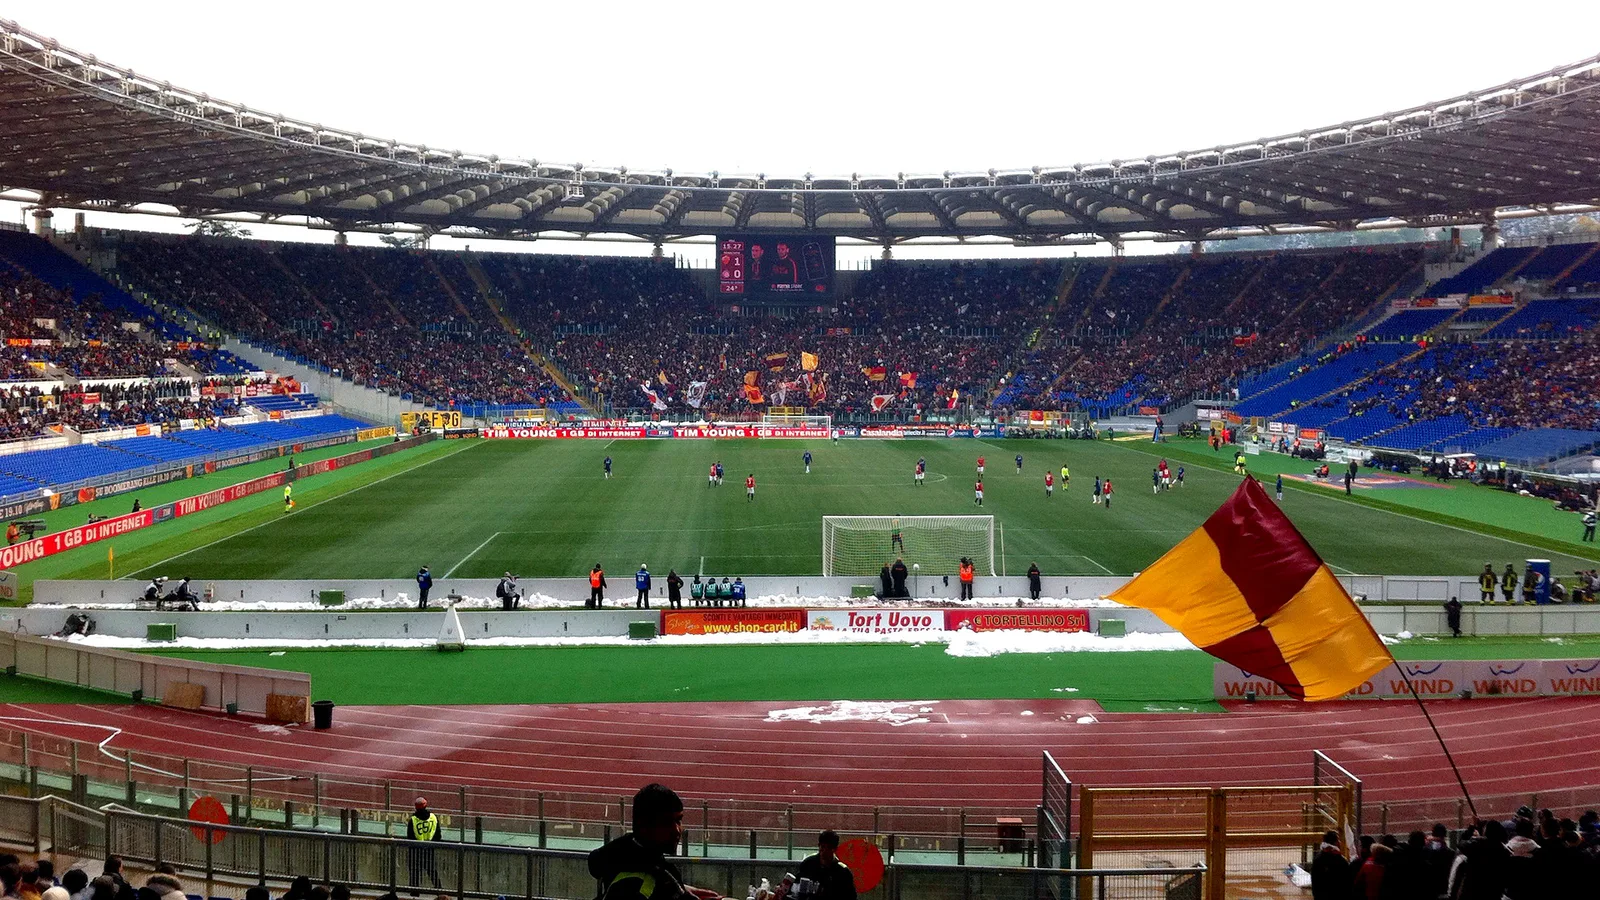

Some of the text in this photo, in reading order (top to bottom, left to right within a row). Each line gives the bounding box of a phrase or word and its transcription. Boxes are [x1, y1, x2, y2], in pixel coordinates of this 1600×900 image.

[734, 257, 740, 266] 1
[733, 269, 741, 279] 0
[676, 429, 698, 437] TIM
[702, 429, 745, 437] YOUNG
[860, 428, 904, 436] Casalandia
[104, 478, 143, 496] BOOMERANG
[180, 499, 196, 515] TIM
[198, 490, 225, 509] YOUNG
[230, 489, 235, 499] 1
[236, 484, 247, 497] GB
[254, 476, 283, 491] INTERNET
[54, 535, 61, 550] 1
[64, 529, 82, 548] GB
[86, 527, 97, 542] DI
[100, 514, 147, 537] INTERNET
[703, 613, 728, 621] SCONTI
[734, 613, 764, 621] VANTAGGI
[764, 613, 798, 621] IMMEDIATI
[848, 612, 932, 627] Tort Uovo
[984, 614, 1065, 626] TORTELLINO
[1068, 614, 1086, 626] Srl
[703, 621, 798, 632] www.shop-card.it
[1390, 679, 1454, 695] WIND
